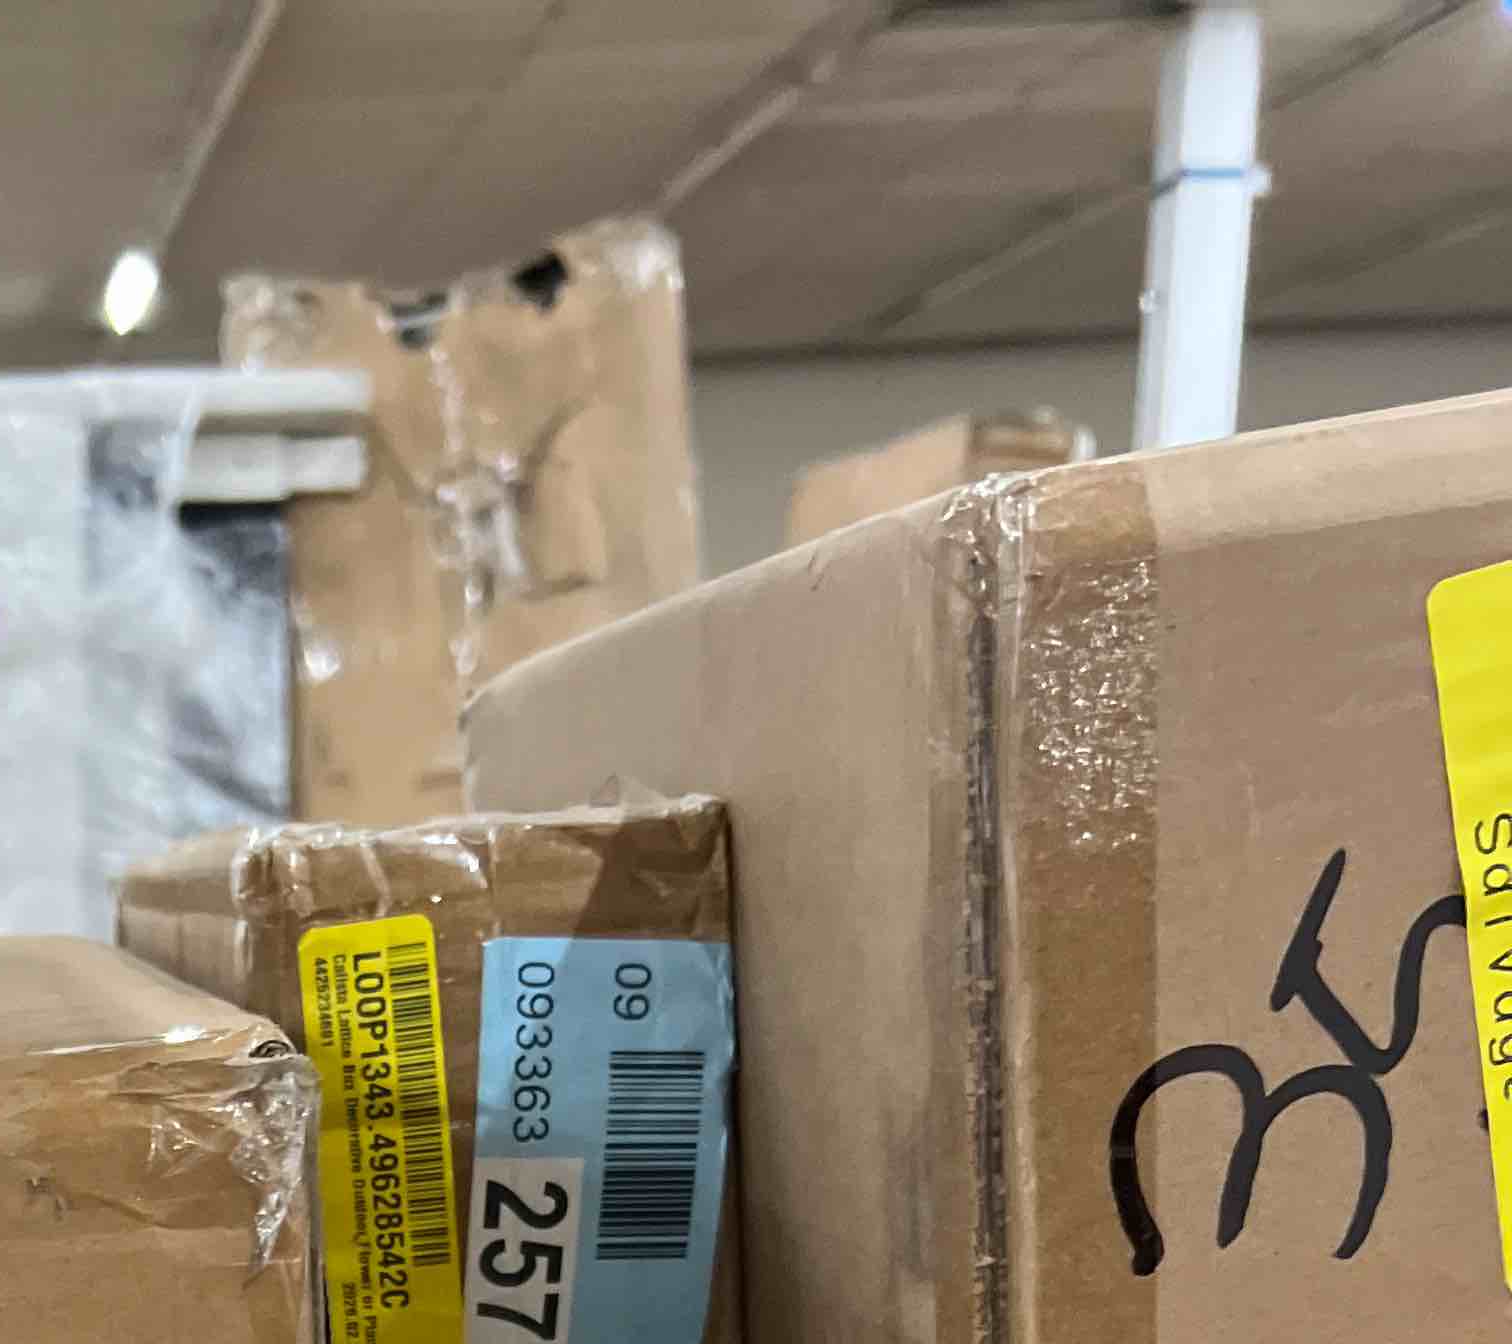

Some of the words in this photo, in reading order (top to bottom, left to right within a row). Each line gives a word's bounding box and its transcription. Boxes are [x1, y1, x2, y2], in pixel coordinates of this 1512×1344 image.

[613, 963, 652, 1022] 09
[1474, 812, 1512, 1100] Salvag
[513, 962, 555, 1143] 093363
[475, 1179, 568, 1342] 257
